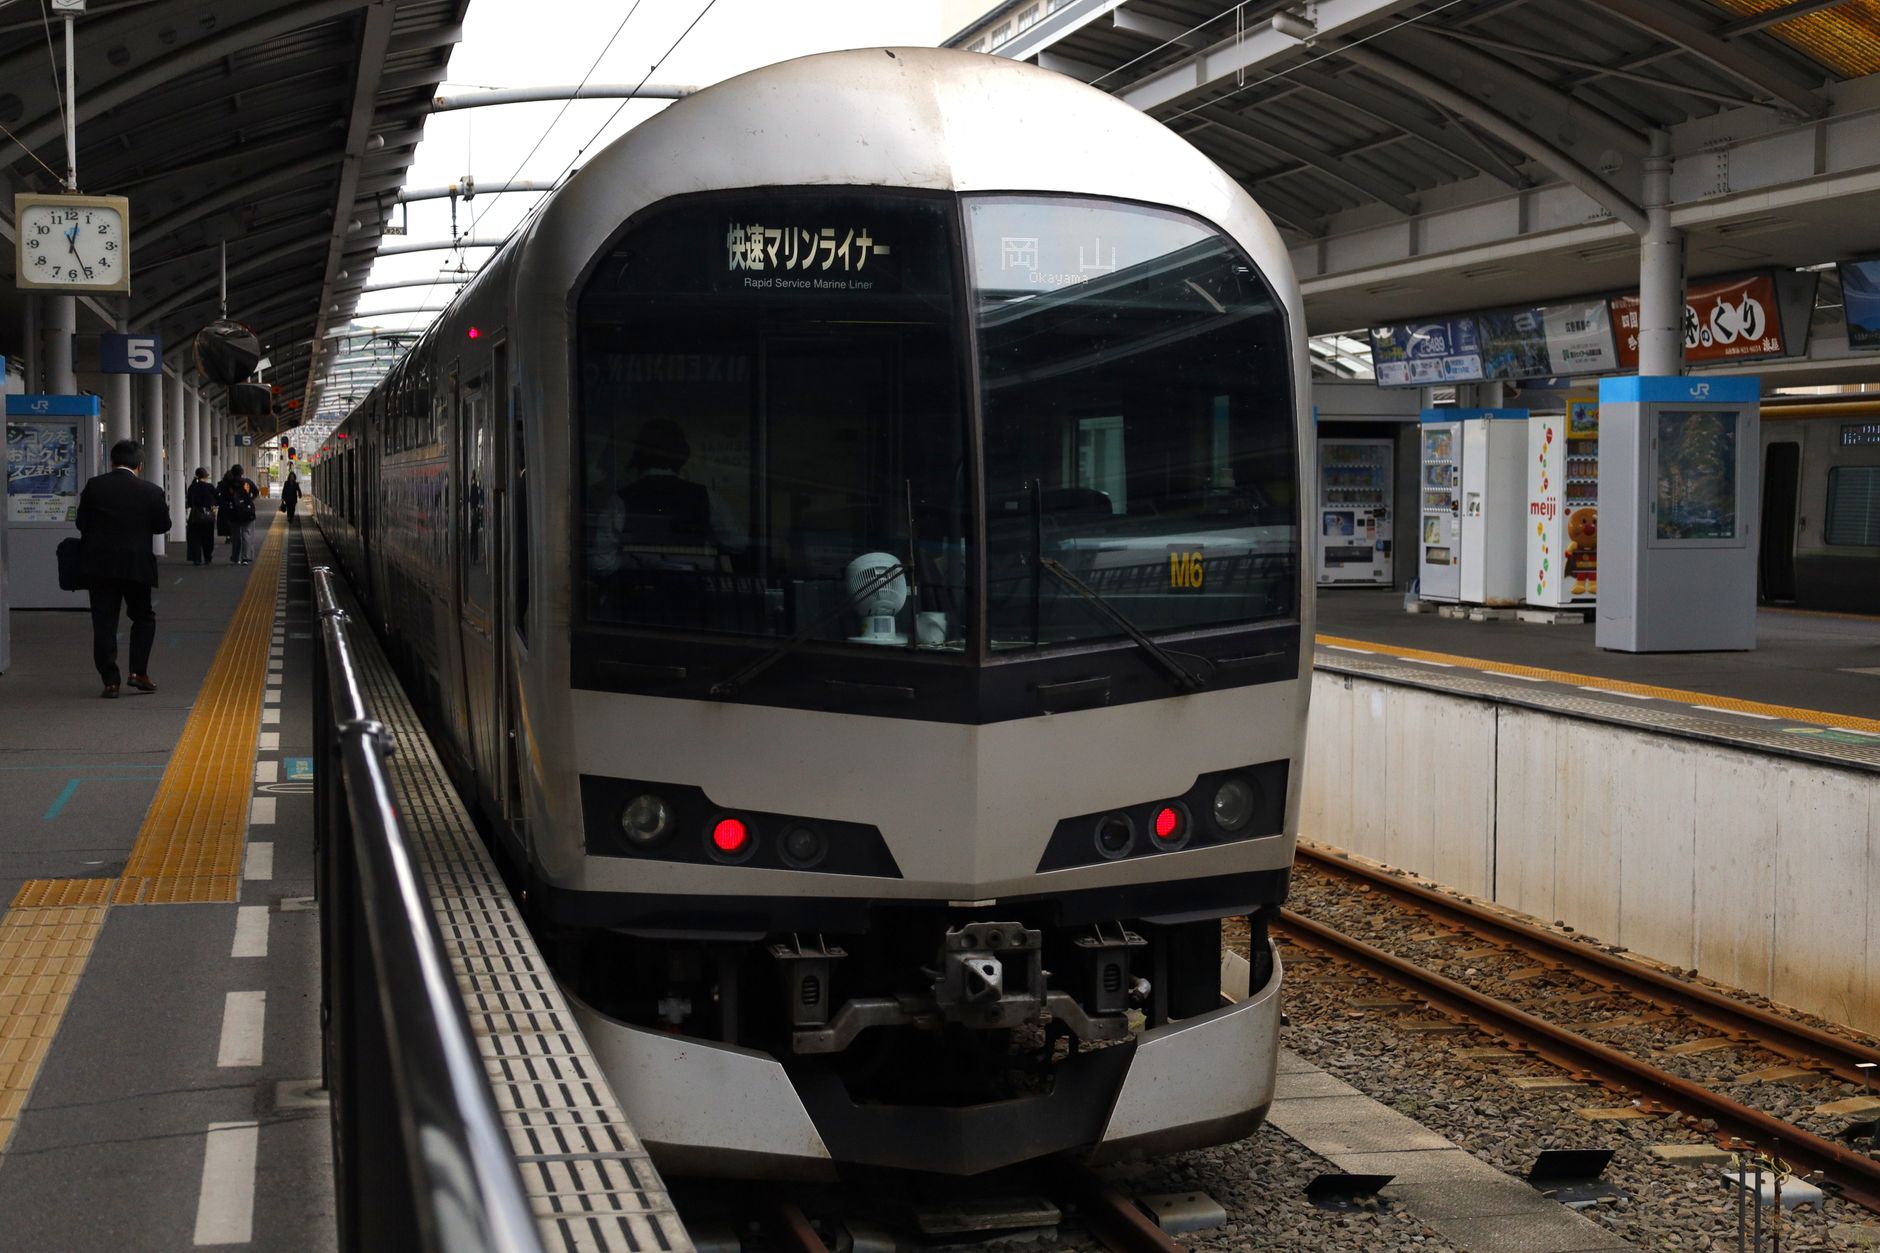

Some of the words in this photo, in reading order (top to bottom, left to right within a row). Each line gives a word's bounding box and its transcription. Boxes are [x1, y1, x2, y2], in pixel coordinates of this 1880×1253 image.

[51, 215, 63, 225] 11
[65, 211, 79, 221] 12
[85, 215, 91, 225] 1
[37, 225, 50, 235] 10
[98, 224, 107, 235] 2
[30, 239, 39, 249] 9
[105, 241, 114, 251] 3
[727, 223, 891, 271] 快速マリンライナー
[1001, 236, 1116, 272] 岡山
[37, 255, 47, 265] 8
[98, 257, 107, 267] 4
[52, 266, 62, 276] 7
[68, 269, 78, 279] 6
[83, 266, 94, 277] 5
[744, 277, 773, 289] Rapid
[775, 278, 811, 289] Service
[813, 279, 846, 289] Marine
[849, 280, 873, 290] Liner
[1029, 272, 1089, 285] Okayama
[127, 338, 155, 369] 5
[1690, 383, 1710, 395] JR
[31, 400, 49, 410] JR
[242, 435, 252, 446] 5
[1530, 497, 1556, 521] meiji
[1170, 552, 1204, 588] M6
